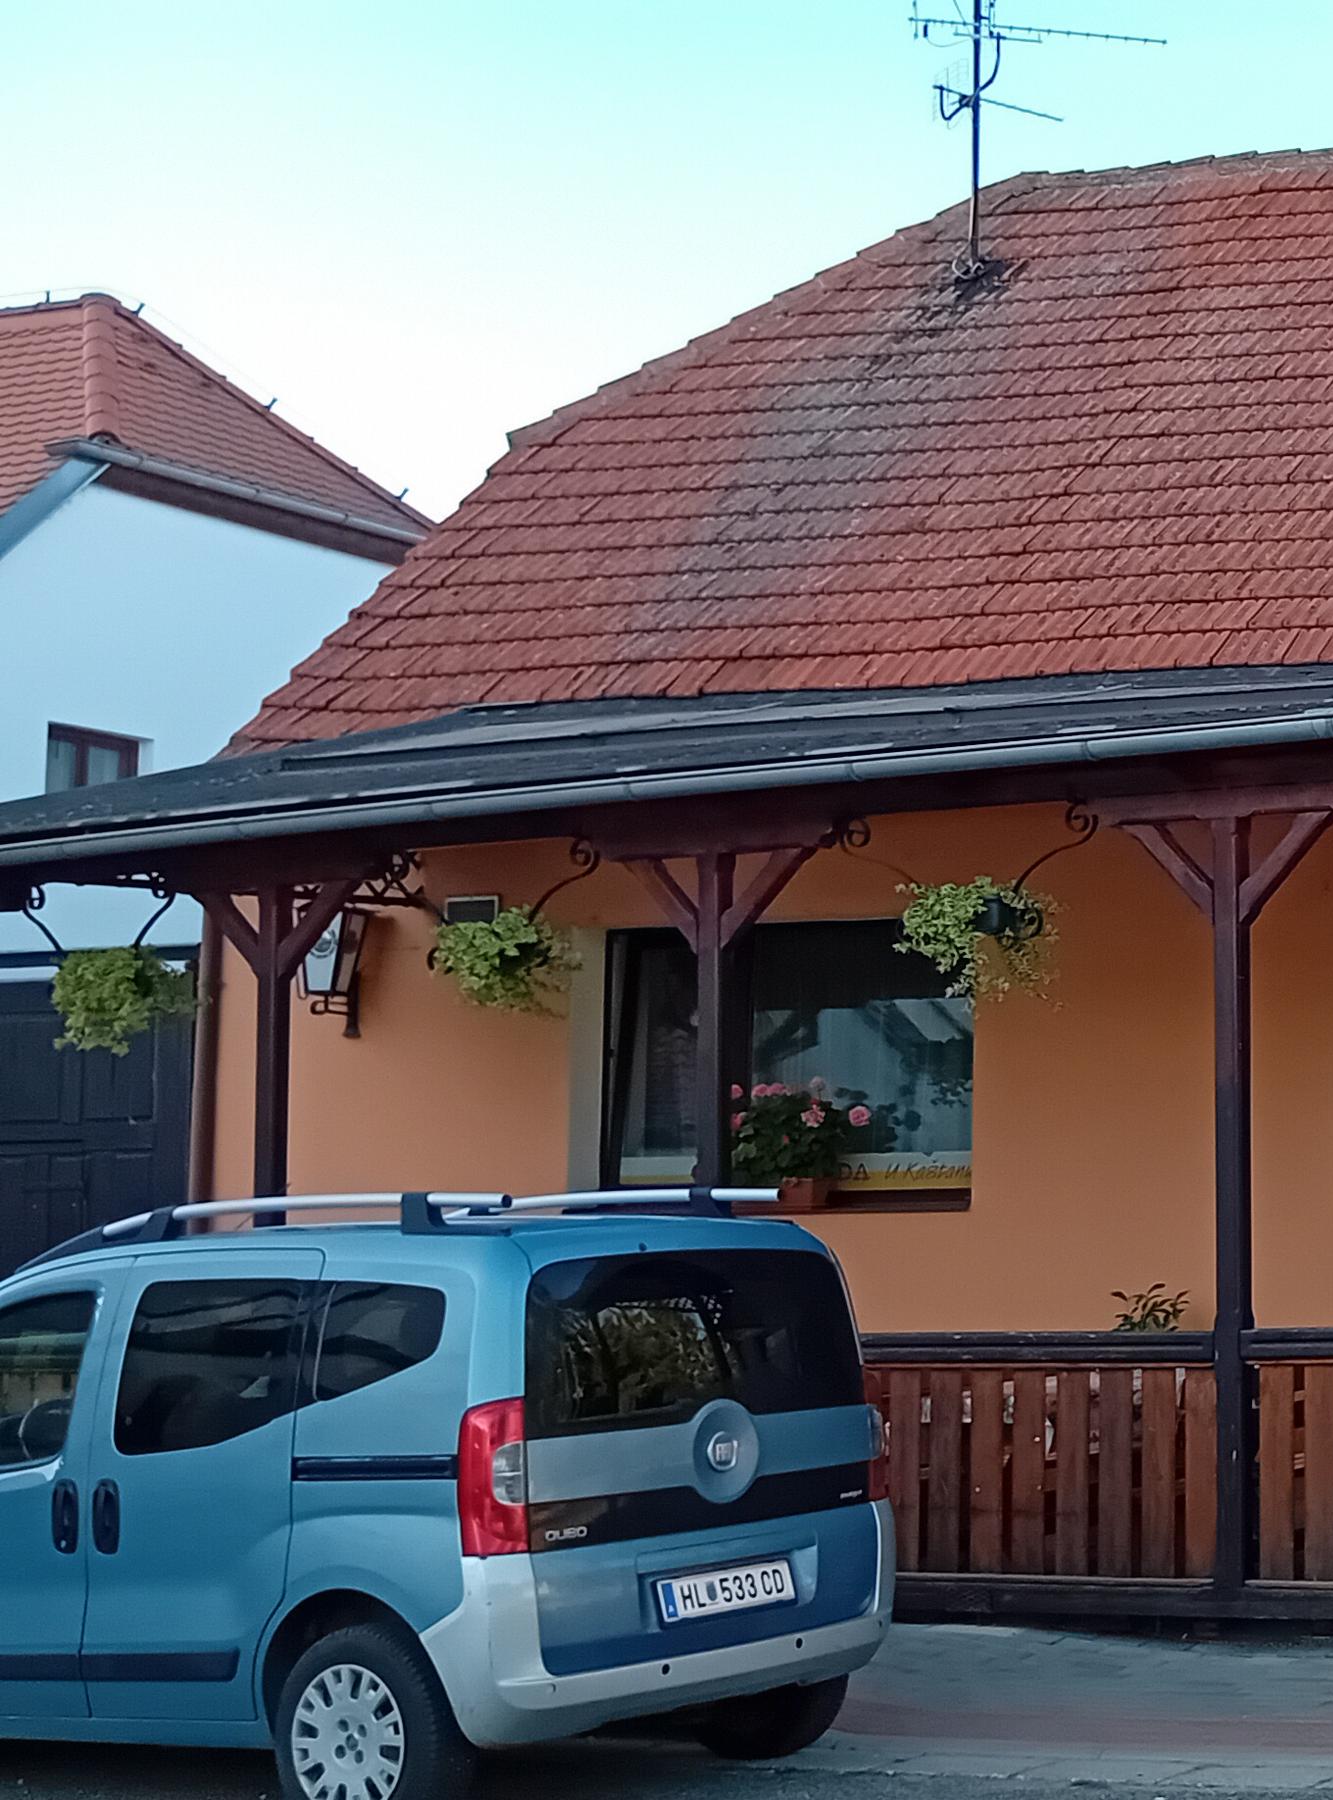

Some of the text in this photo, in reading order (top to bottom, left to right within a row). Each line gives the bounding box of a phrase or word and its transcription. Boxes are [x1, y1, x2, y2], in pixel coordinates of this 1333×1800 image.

[680, 1568, 785, 1611] HL 533 CD
